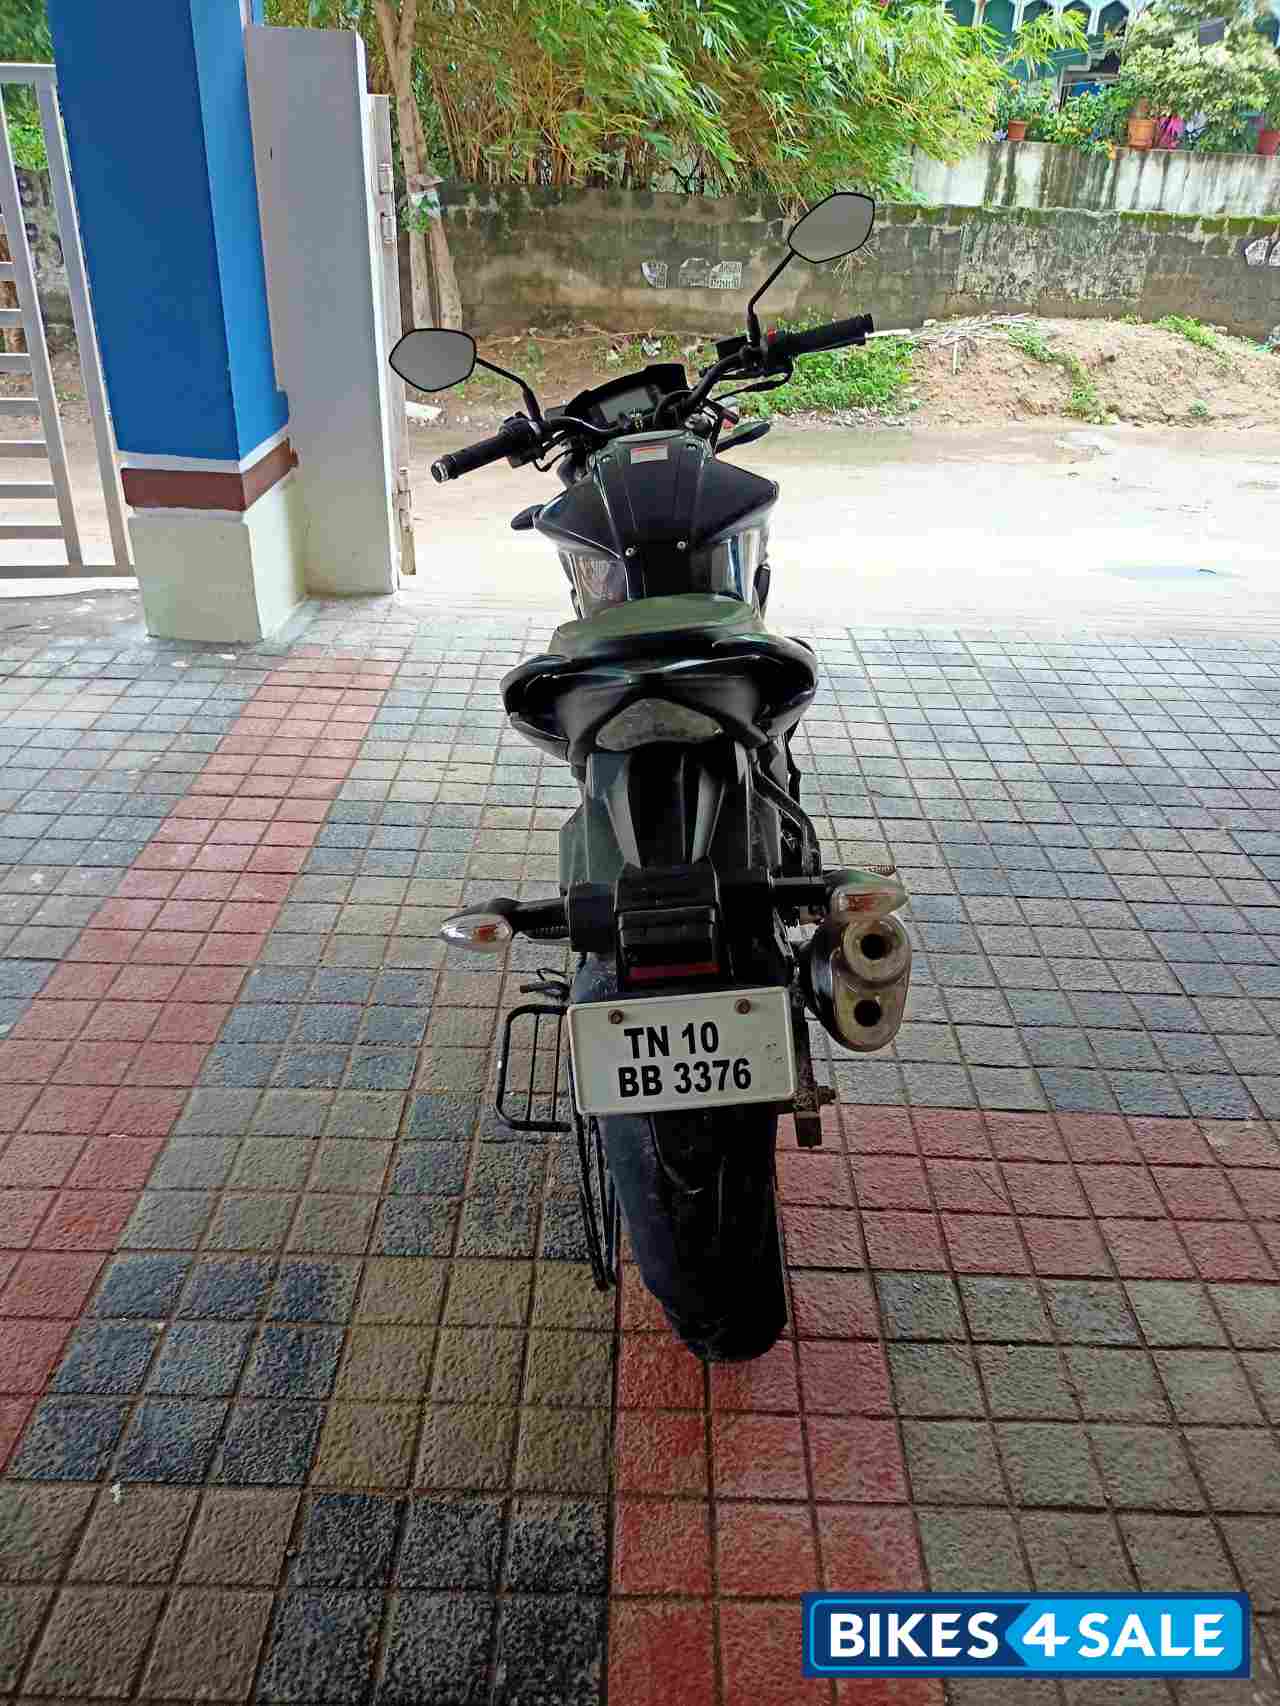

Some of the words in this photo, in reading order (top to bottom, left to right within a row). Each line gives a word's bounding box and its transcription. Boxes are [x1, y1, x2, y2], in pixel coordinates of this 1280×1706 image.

[624, 1025, 670, 1059] TN
[681, 1021, 719, 1055] 10
[618, 1065, 663, 1098] BB
[673, 1057, 751, 1094] 3376
